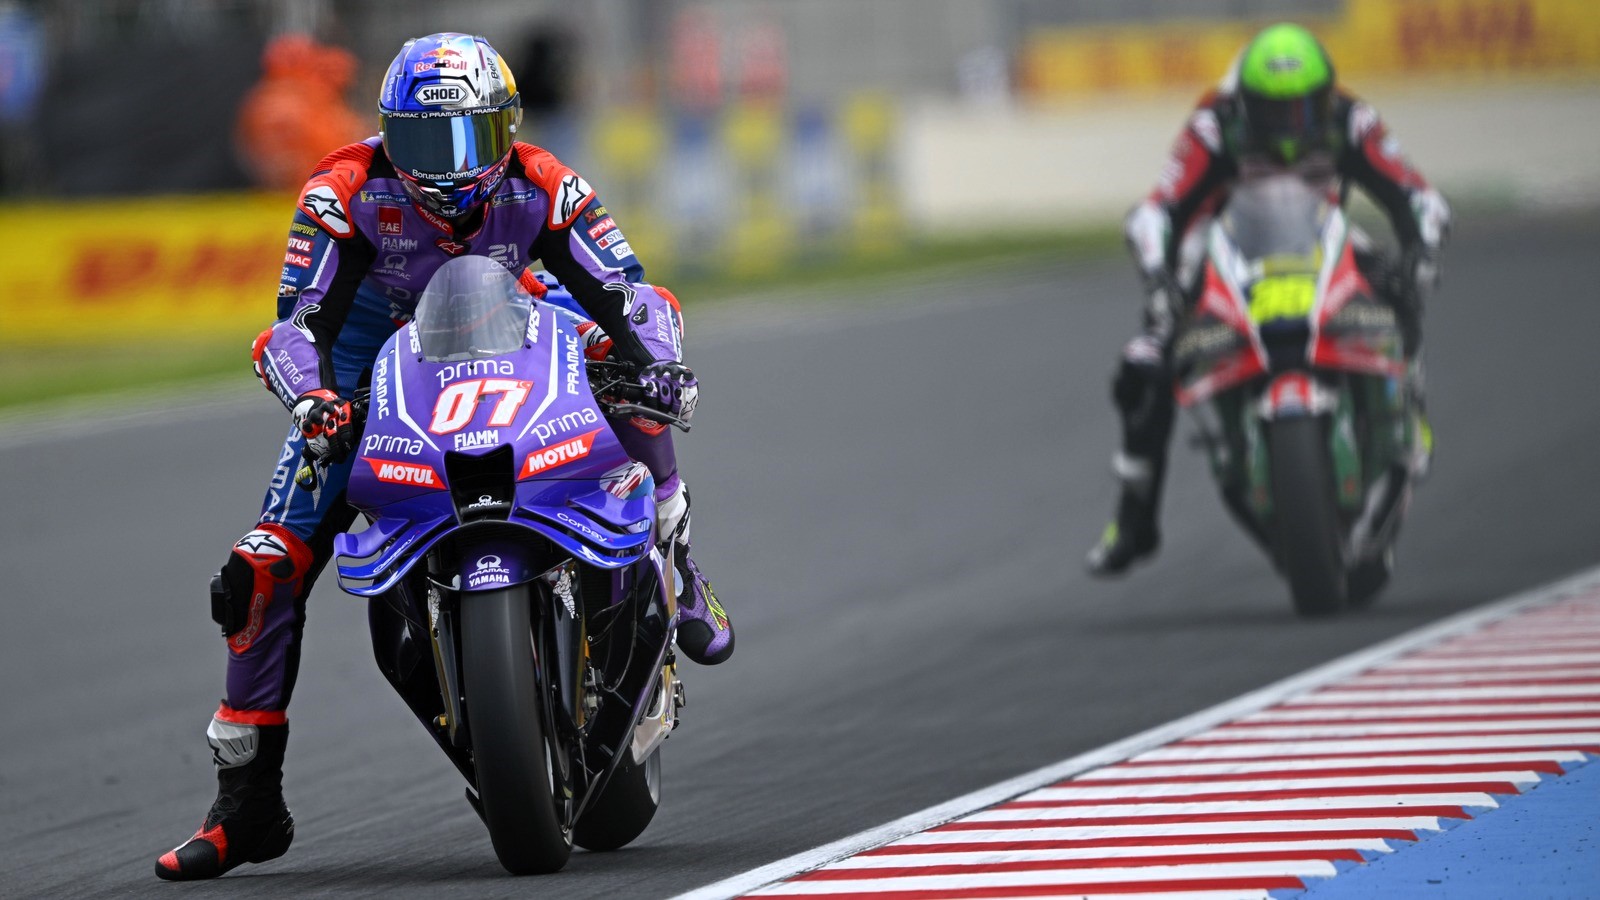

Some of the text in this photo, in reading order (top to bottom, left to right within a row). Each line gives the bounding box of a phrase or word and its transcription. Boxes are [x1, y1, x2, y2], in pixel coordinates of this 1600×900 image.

[422, 87, 460, 101] SHOEI
[392, 106, 500, 119] PRAMAC PRAMAC PRAMAC
[412, 165, 483, 180] Borusan Otomotiv
[379, 222, 400, 233] EAE
[381, 237, 418, 250] FIAMM
[488, 243, 519, 261] 21
[655, 309, 673, 343] prima
[275, 349, 303, 385] prima
[436, 359, 514, 388] prima
[566, 335, 580, 396] PRAMAC
[265, 366, 295, 410] PRAMAC
[376, 357, 390, 420] PRAMAC
[428, 378, 534, 435] 07
[531, 408, 598, 446] prima
[364, 434, 423, 456] prima
[454, 430, 499, 448] FIAMM
[529, 440, 588, 473] MOTUL
[378, 464, 435, 485] MOTUL
[468, 499, 502, 509] PRAMAC
[557, 512, 608, 543] Corpay
[468, 568, 510, 578] PRAMAC
[469, 575, 510, 588] YAMAHA
